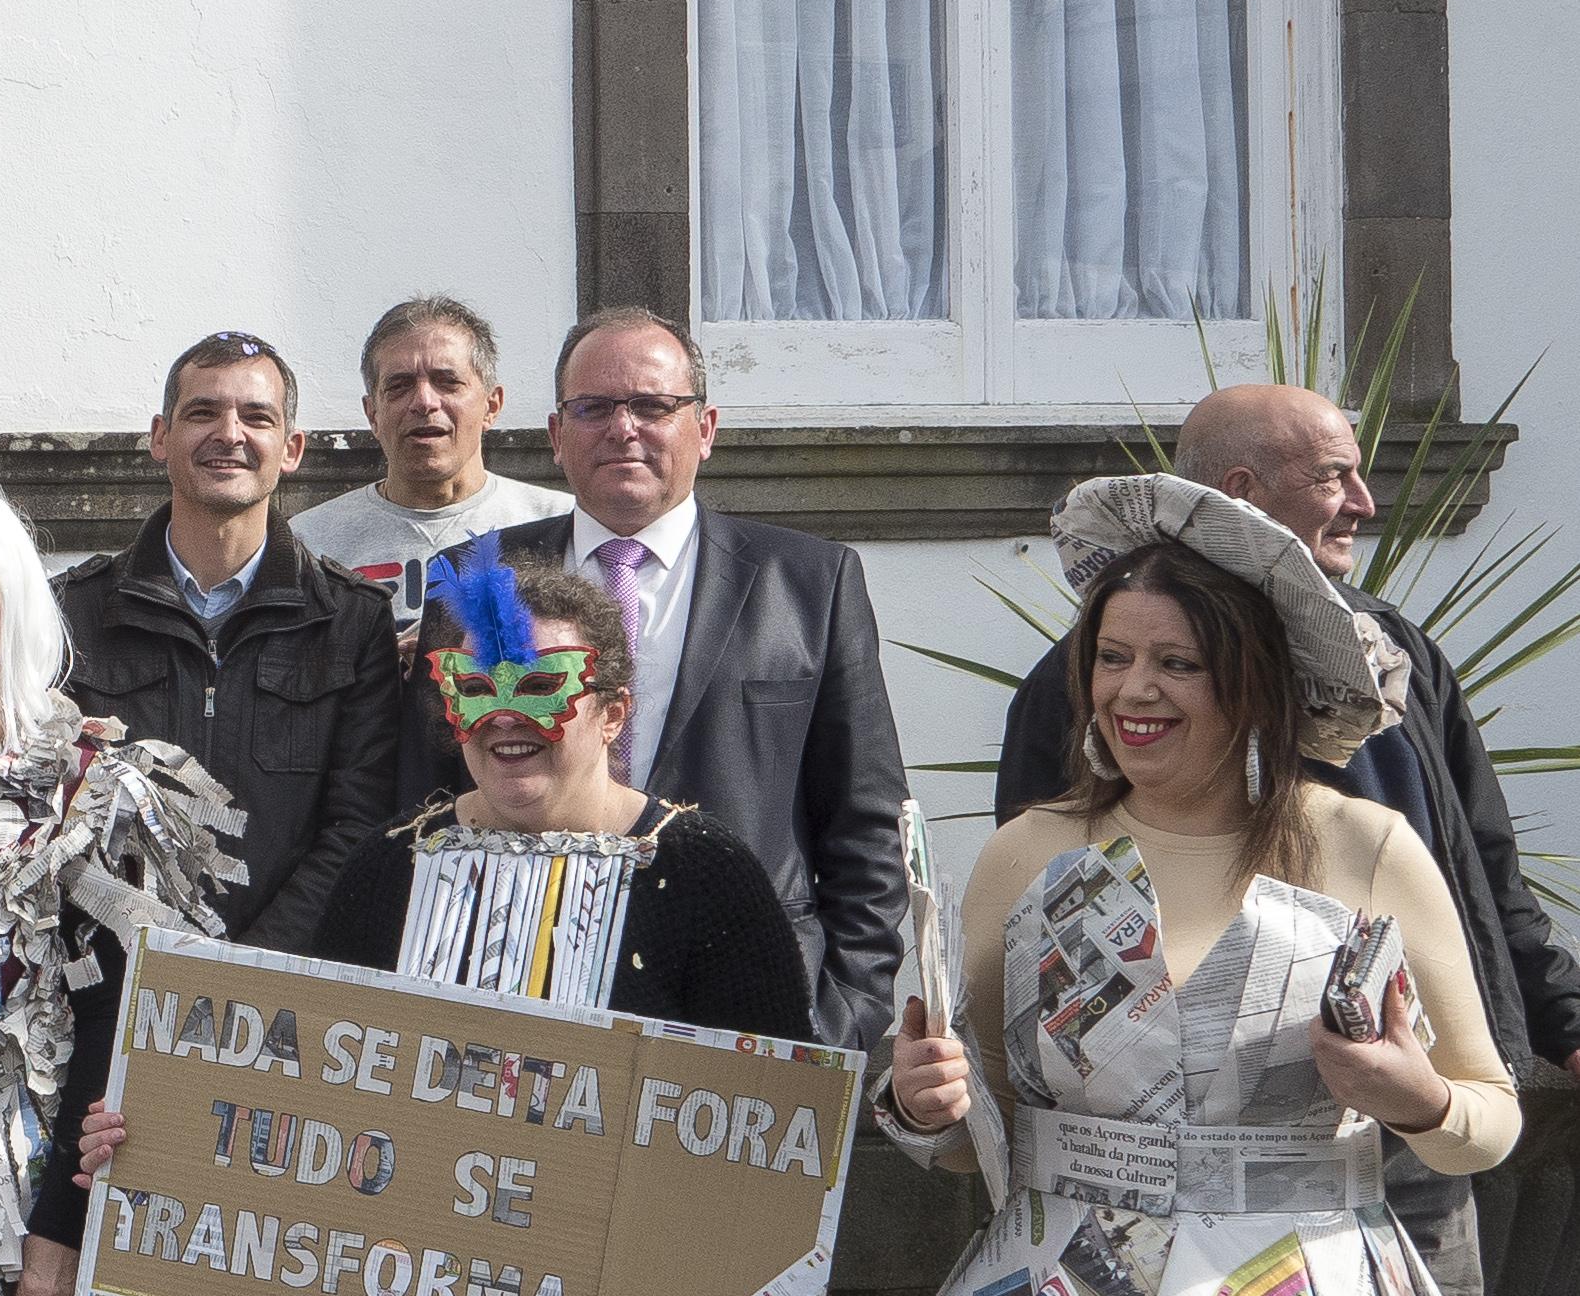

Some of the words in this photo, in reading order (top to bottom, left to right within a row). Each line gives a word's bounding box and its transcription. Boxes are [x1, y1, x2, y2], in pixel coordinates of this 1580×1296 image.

[1109, 912, 1147, 948] ERA
[133, 987, 304, 1080] NADA
[320, 1019, 401, 1097] SE
[411, 1035, 605, 1137] DEITA
[632, 1076, 823, 1179] FORA
[1058, 1120, 1077, 1138] que
[1077, 1125, 1093, 1138] os
[1093, 1124, 1137, 1147] Açores
[1183, 1131, 1198, 1142] do
[1200, 1131, 1236, 1143] estado
[1238, 1131, 1253, 1142] do
[1254, 1131, 1290, 1145] tempo
[1290, 1133, 1308, 1143] nos
[1070, 1138, 1107, 1161] batalha
[1108, 1146, 1125, 1162] da
[211, 1099, 397, 1197] TUDO
[453, 1150, 538, 1229] SE
[1069, 1158, 1084, 1173] da
[1084, 1164, 1114, 1180] nossa
